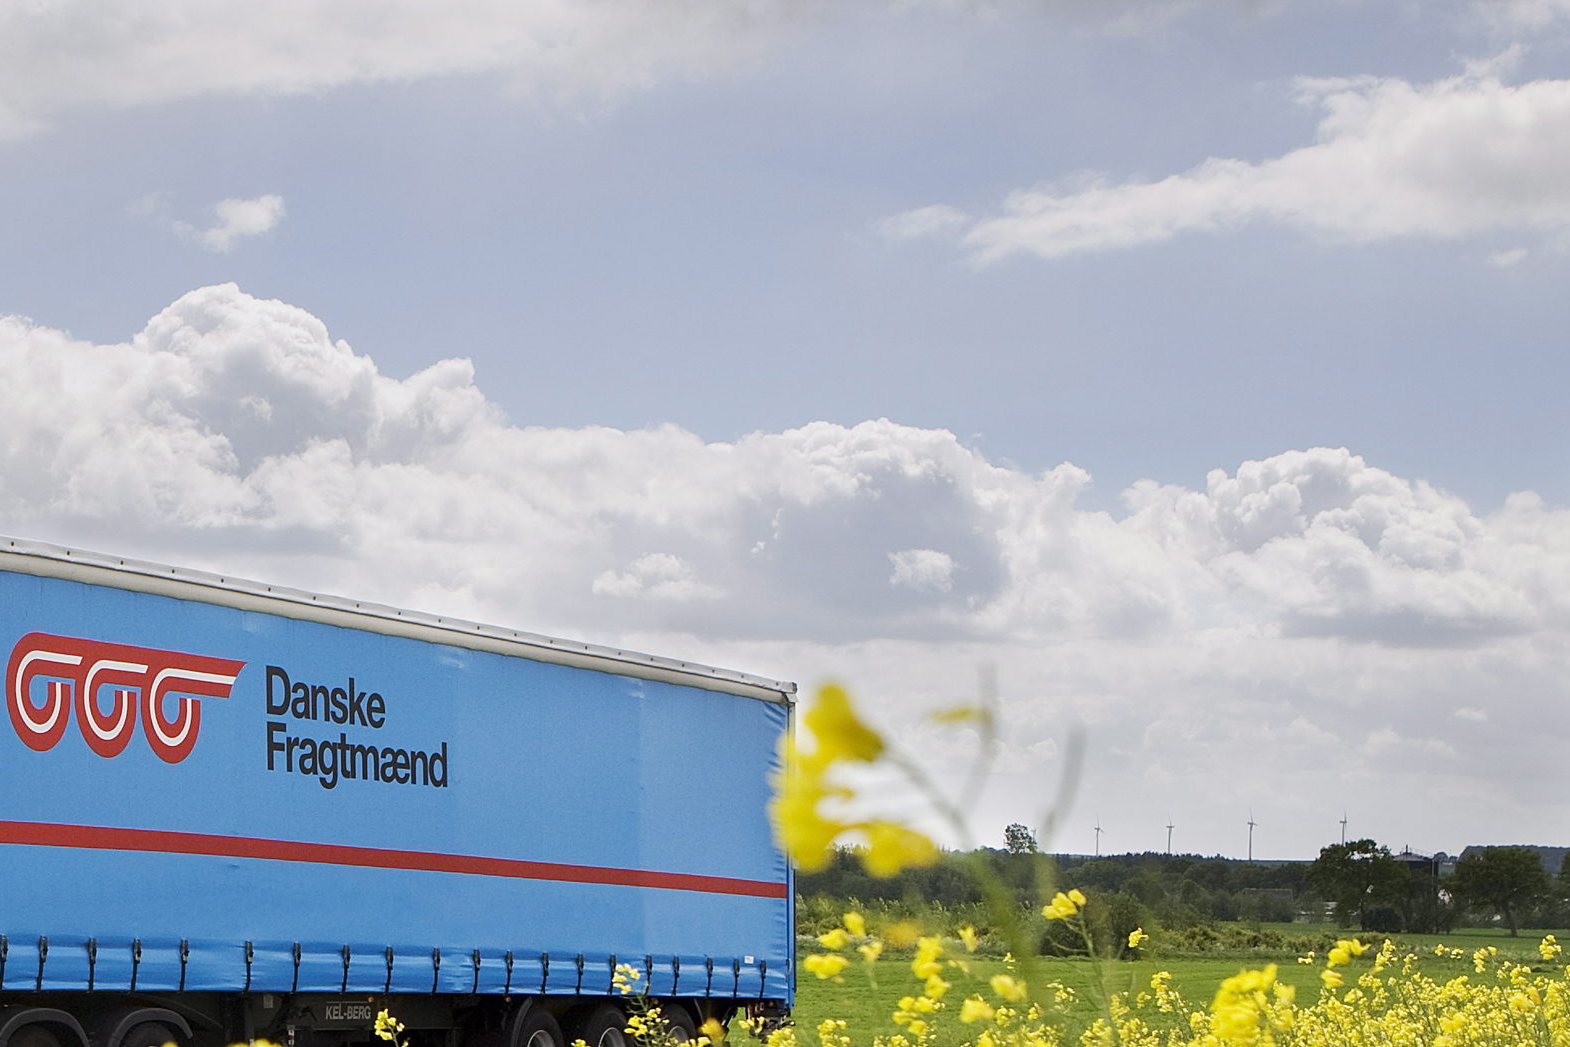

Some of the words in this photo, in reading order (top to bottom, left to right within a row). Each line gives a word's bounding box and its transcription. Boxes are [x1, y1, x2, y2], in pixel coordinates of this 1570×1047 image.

[266, 665, 386, 729] Danske
[266, 721, 448, 790] Fragtmænd
[325, 1004, 371, 1020] KEL-BERG
